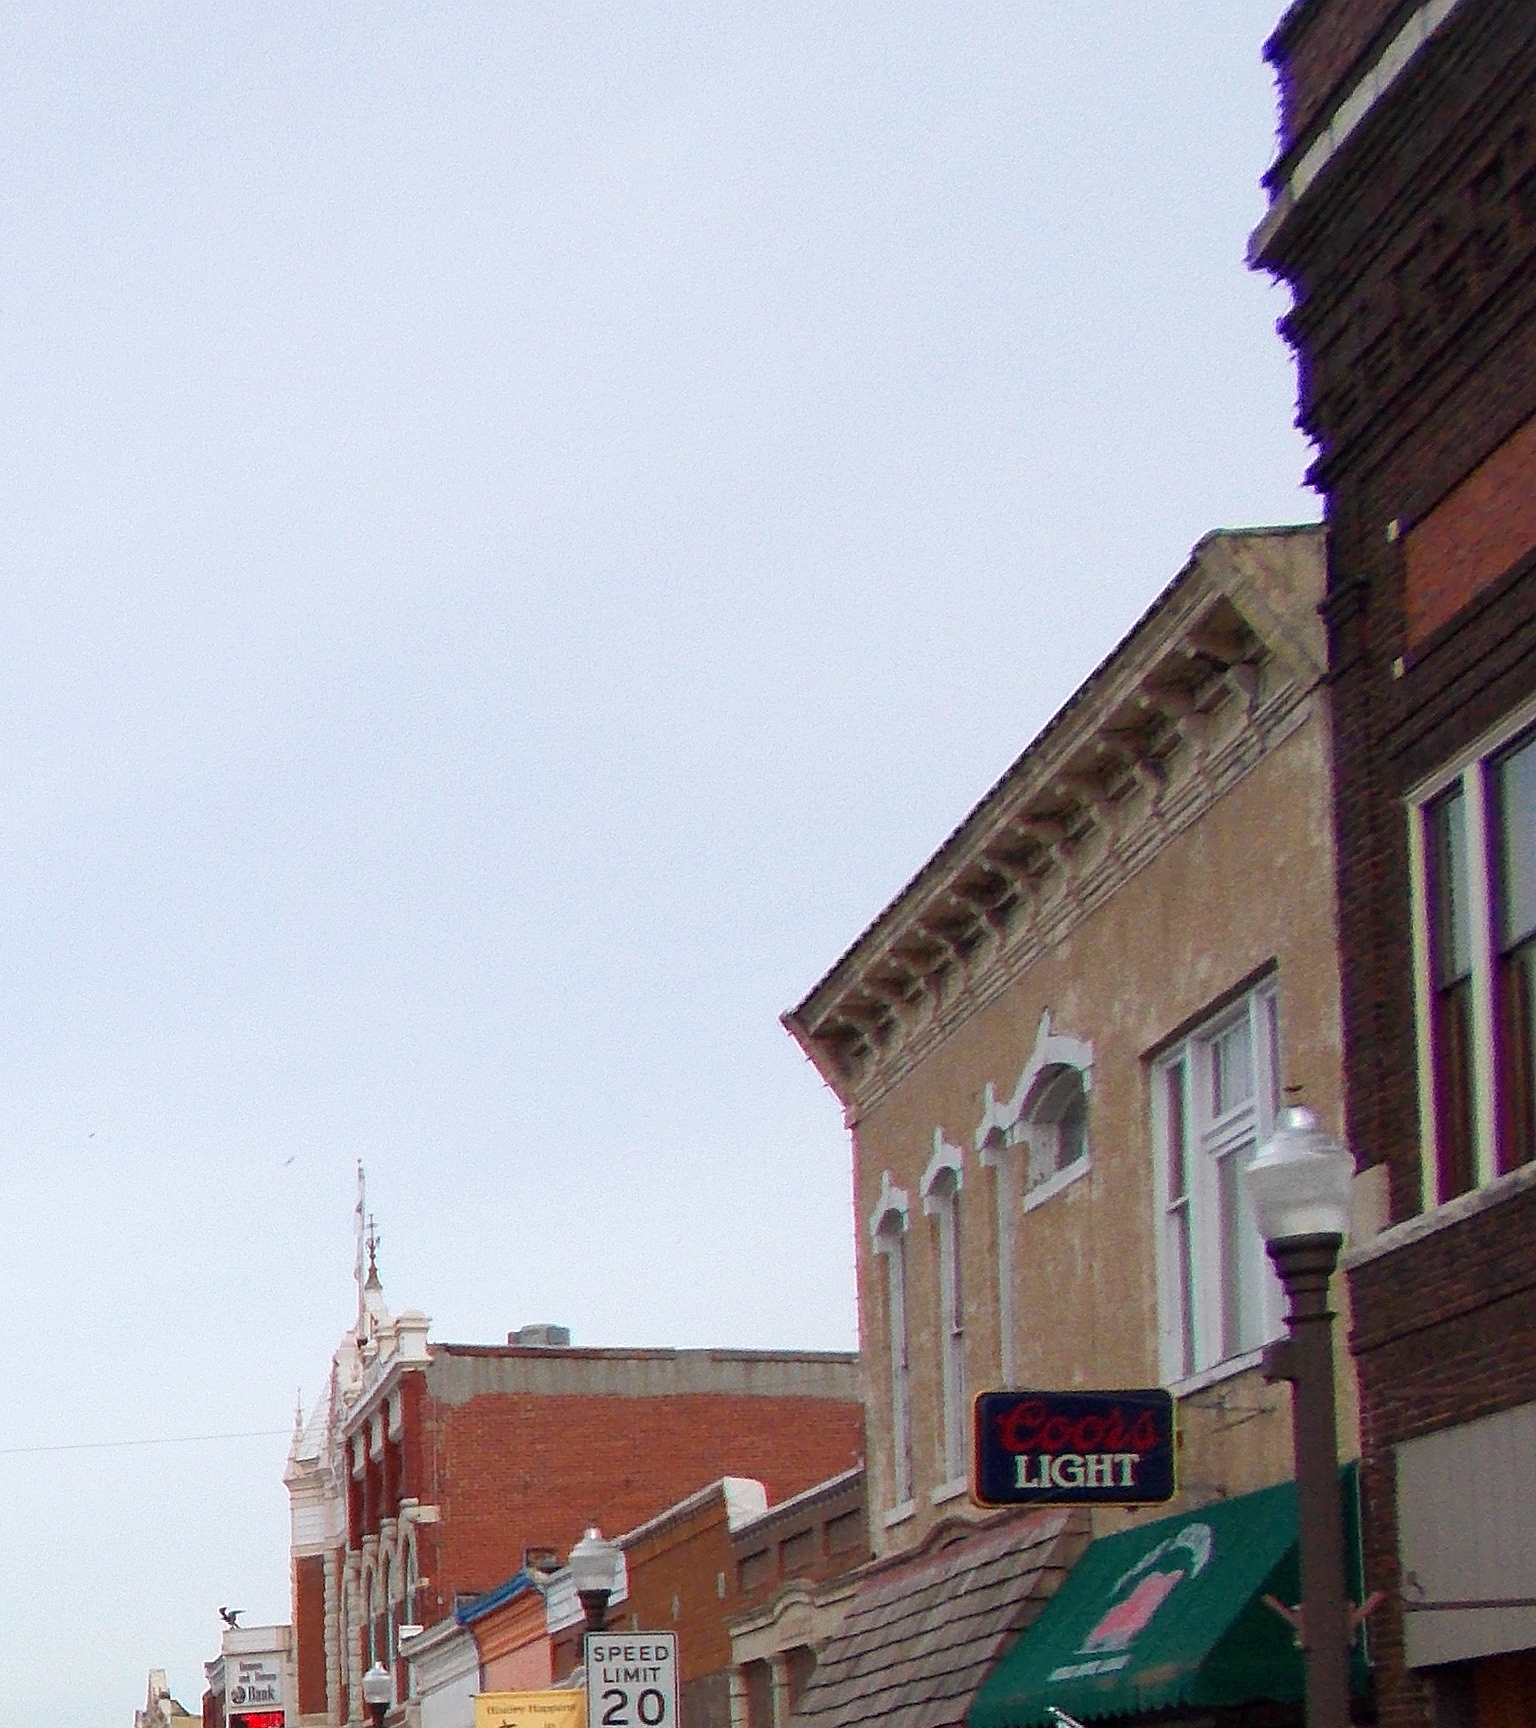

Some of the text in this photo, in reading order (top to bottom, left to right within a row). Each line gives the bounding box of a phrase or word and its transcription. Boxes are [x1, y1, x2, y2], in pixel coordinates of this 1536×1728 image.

[995, 1399, 1161, 1452] Coors
[1014, 1453, 1141, 1488] LIGHT
[593, 1645, 669, 1662] SPEED
[603, 1667, 661, 1683] LIMIT
[248, 1684, 276, 1702] Bank
[601, 1687, 665, 1726] 20
